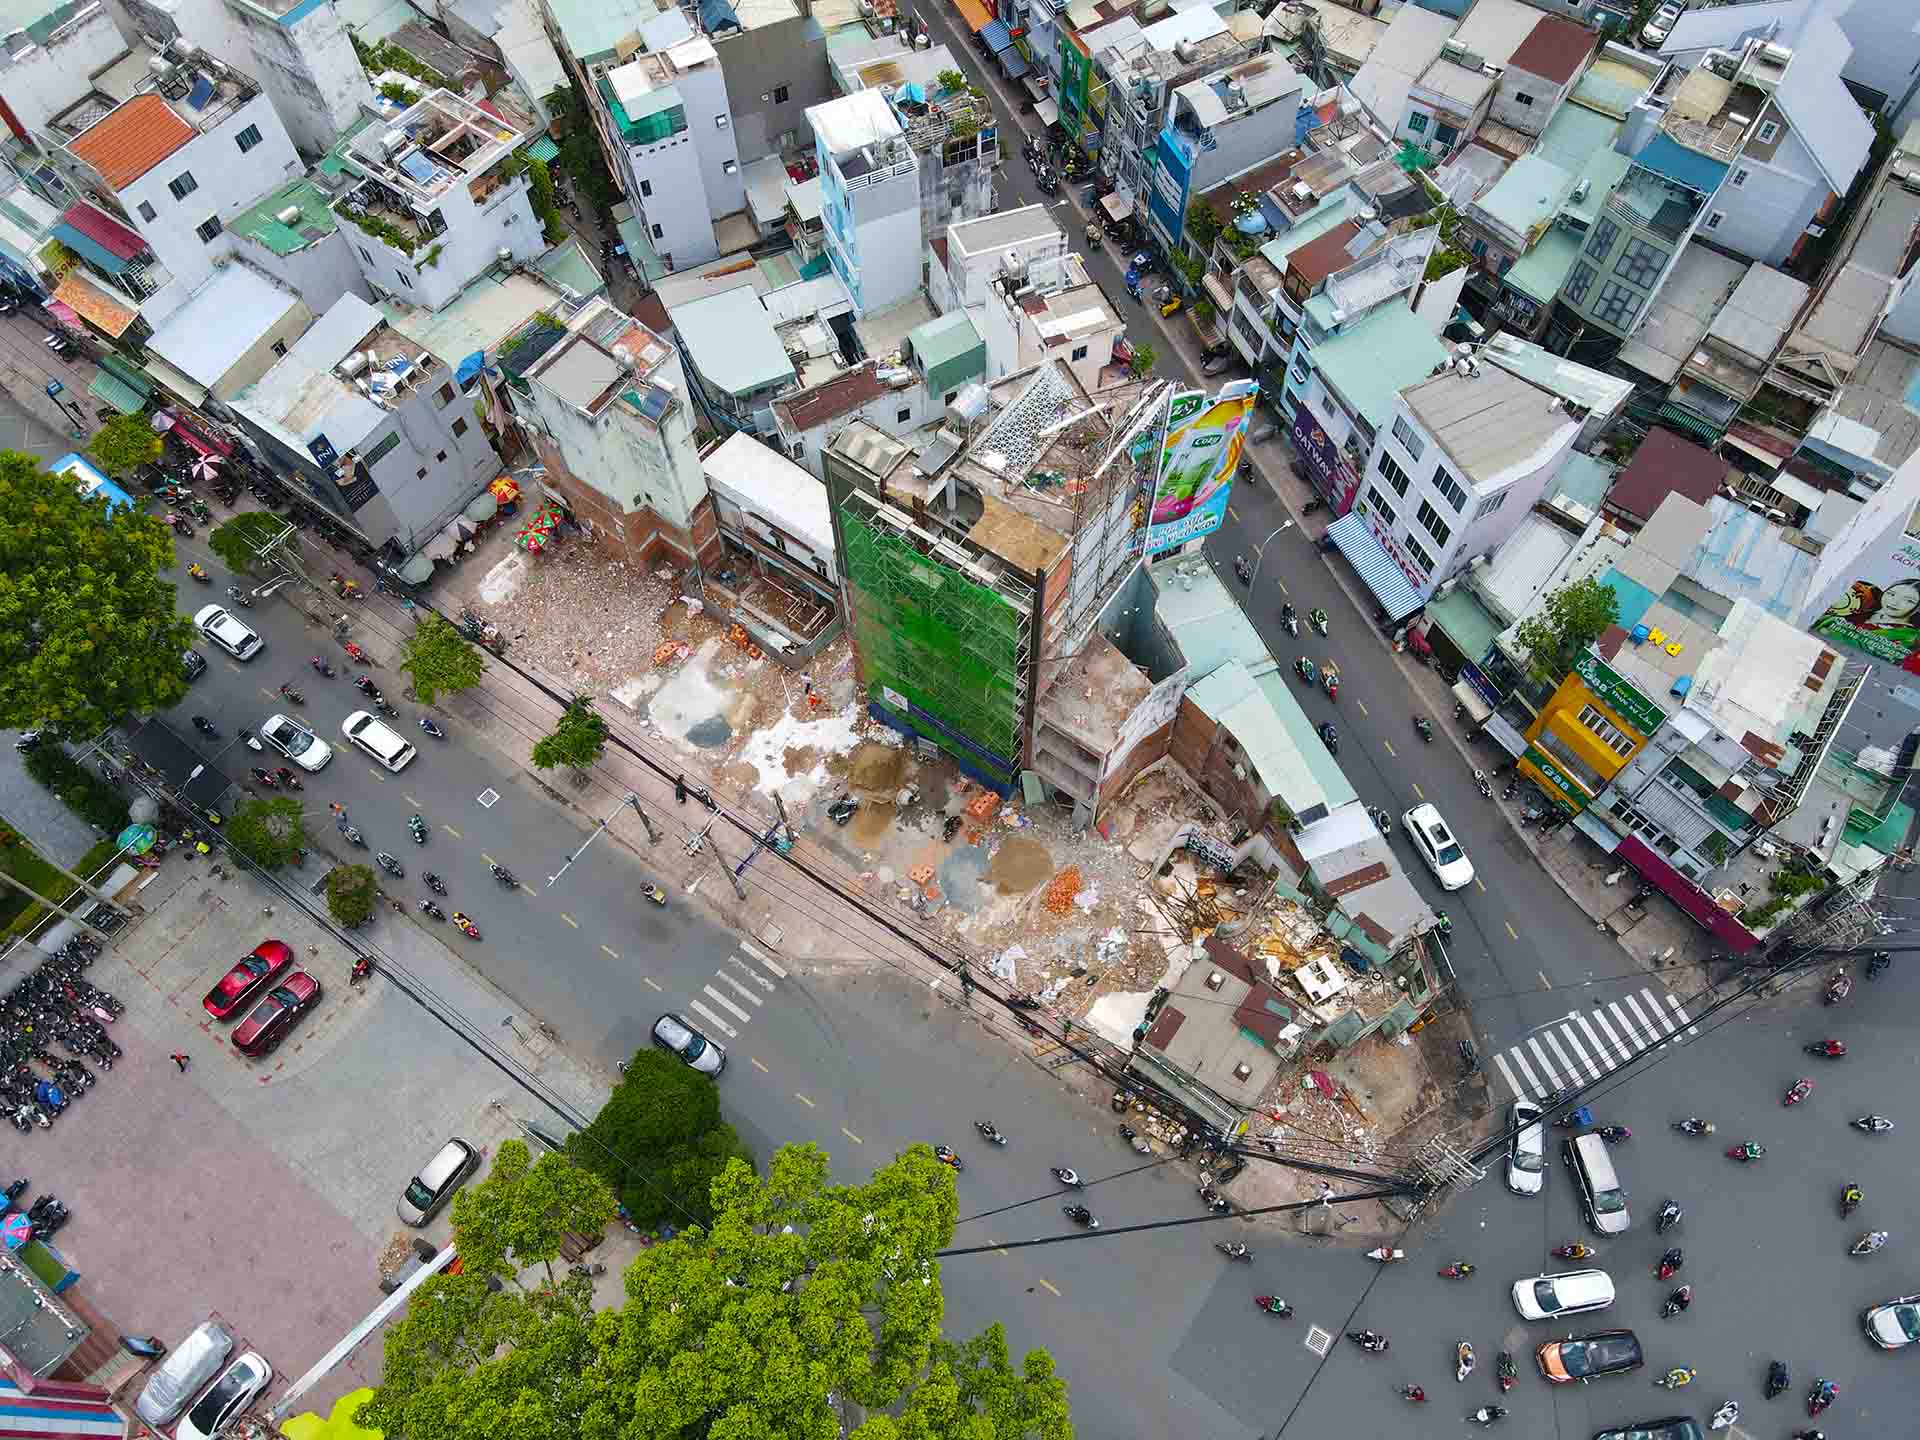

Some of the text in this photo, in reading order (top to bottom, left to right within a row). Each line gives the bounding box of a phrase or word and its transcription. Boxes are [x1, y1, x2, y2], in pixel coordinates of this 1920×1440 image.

[317, 447, 334, 462] PNJ
[1295, 426, 1332, 476] OATWAY
[1582, 668, 1608, 692] G88
[1541, 763, 1571, 792] G88
